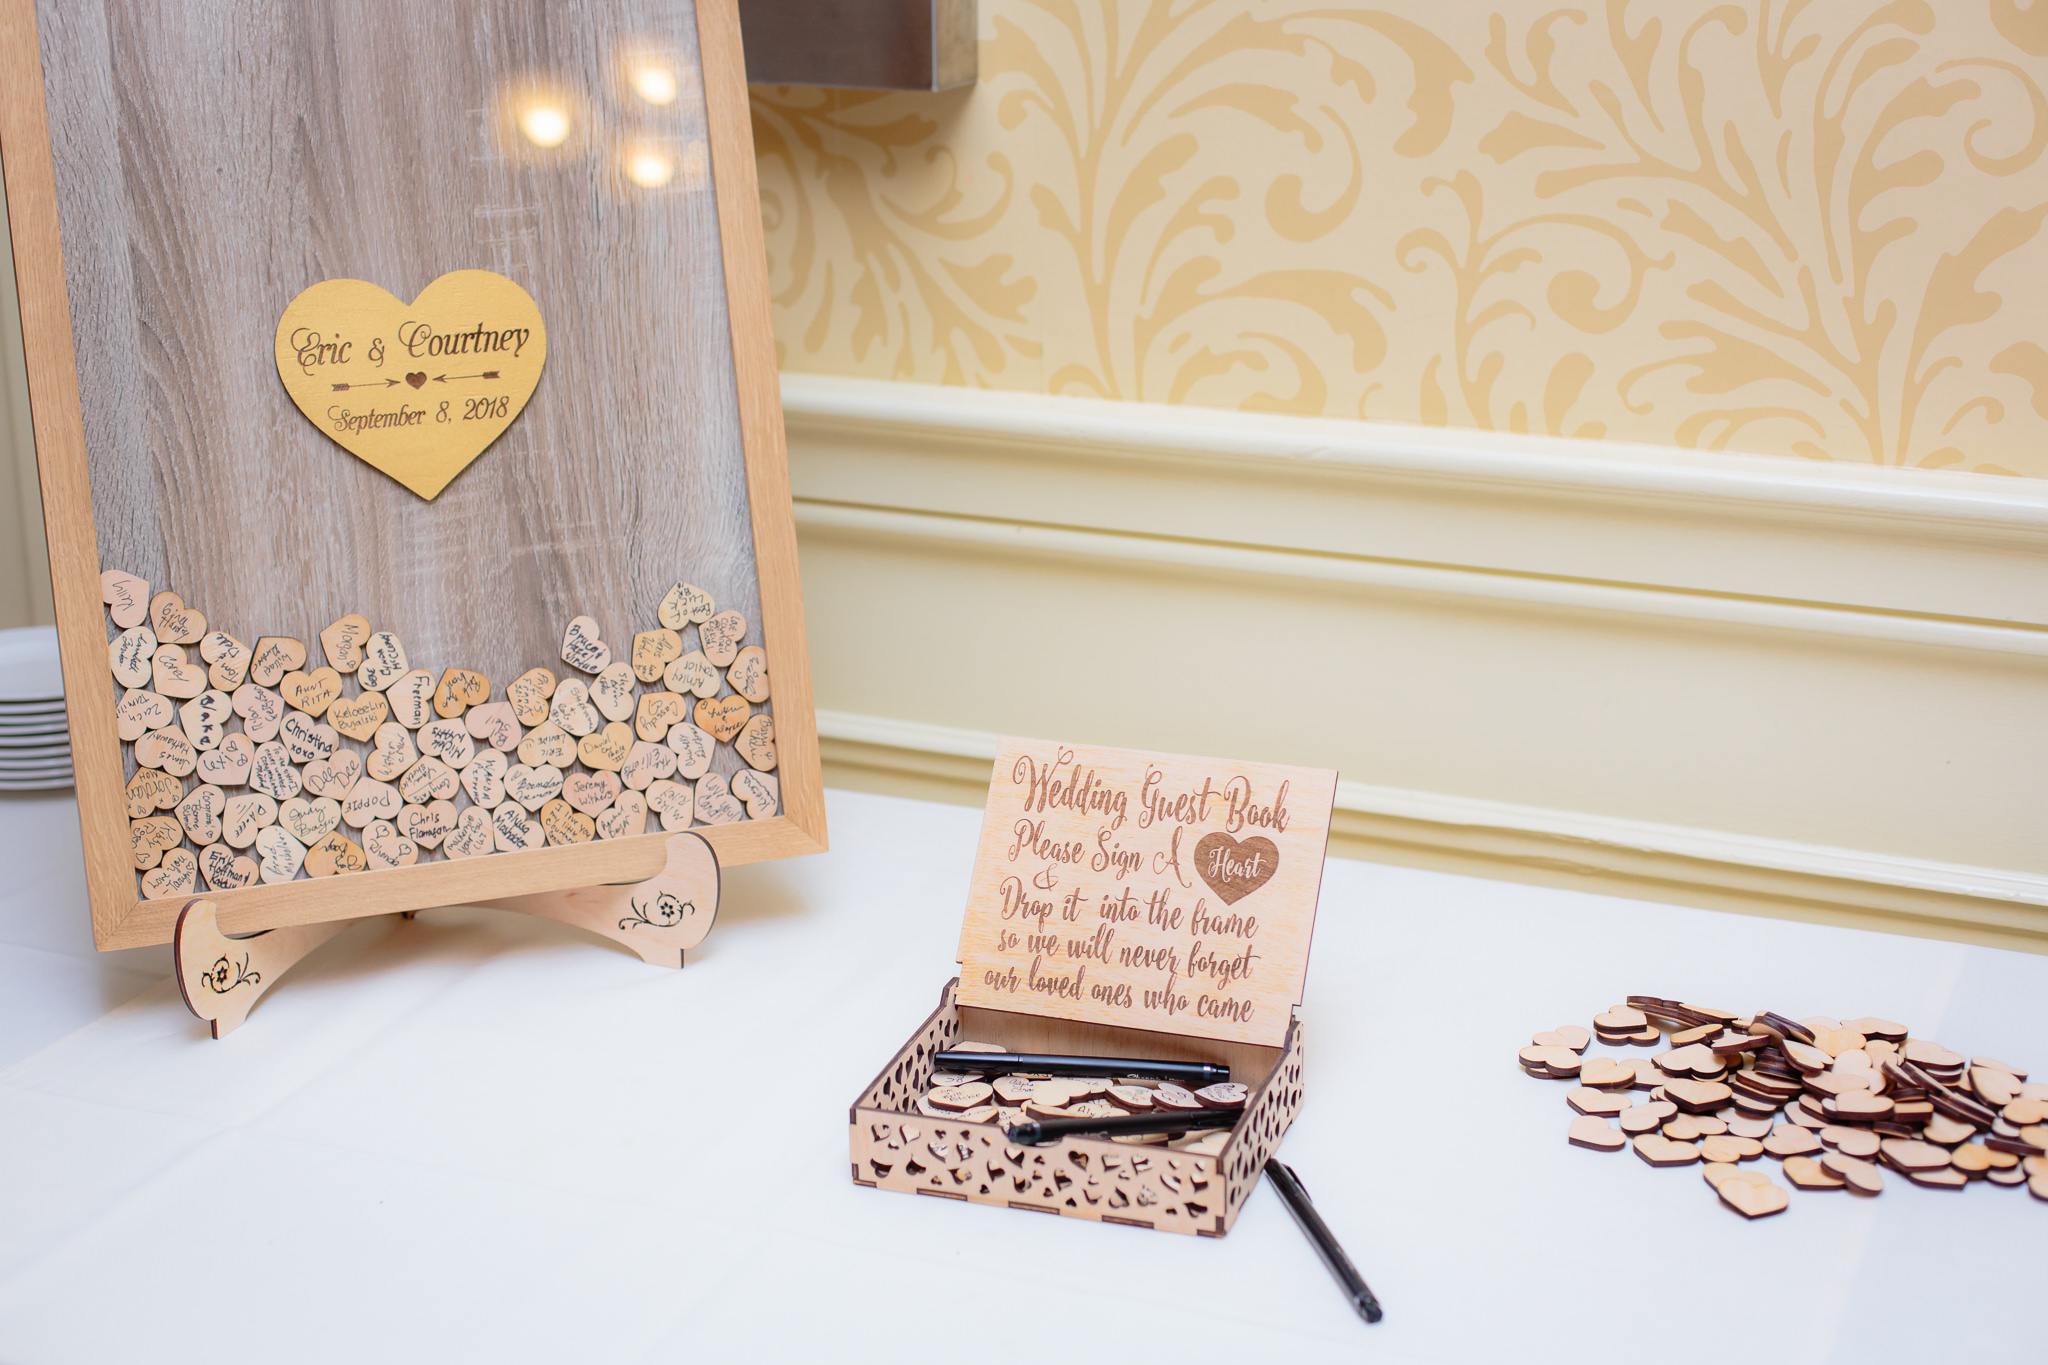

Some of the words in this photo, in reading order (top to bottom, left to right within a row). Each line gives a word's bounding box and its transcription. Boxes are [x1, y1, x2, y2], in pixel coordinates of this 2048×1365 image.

[290, 327, 352, 376] Eric
[368, 337, 385, 367] &
[398, 321, 529, 358] Courtney
[327, 404, 426, 435] September
[435, 400, 452, 424] 8,
[462, 396, 510, 420] 2018
[412, 676, 430, 725] Freeman
[284, 718, 333, 754] Christina
[1012, 745, 1128, 830] Wedding
[1138, 763, 1222, 829] Guest
[1223, 775, 1291, 834] Book
[1007, 818, 1085, 865] Please
[1091, 825, 1144, 881] Sign
[1152, 825, 1192, 888] A
[1207, 845, 1268, 883] Heart
[1033, 863, 1059, 892] &
[1000, 875, 1054, 934] Drop
[1062, 886, 1089, 922] it
[1100, 886, 1140, 922] into
[1144, 888, 1184, 931] the
[1191, 898, 1259, 939] frame
[997, 929, 1020, 952] so
[1028, 931, 1060, 957] we
[1067, 922, 1114, 965] will
[1119, 946, 1181, 975] never
[1187, 941, 1261, 991] forget
[984, 967, 1021, 993] our
[1029, 955, 1085, 1001] loved
[1091, 980, 1132, 1009] ones
[1144, 972, 1190, 1021] who
[1197, 995, 1255, 1023] came
